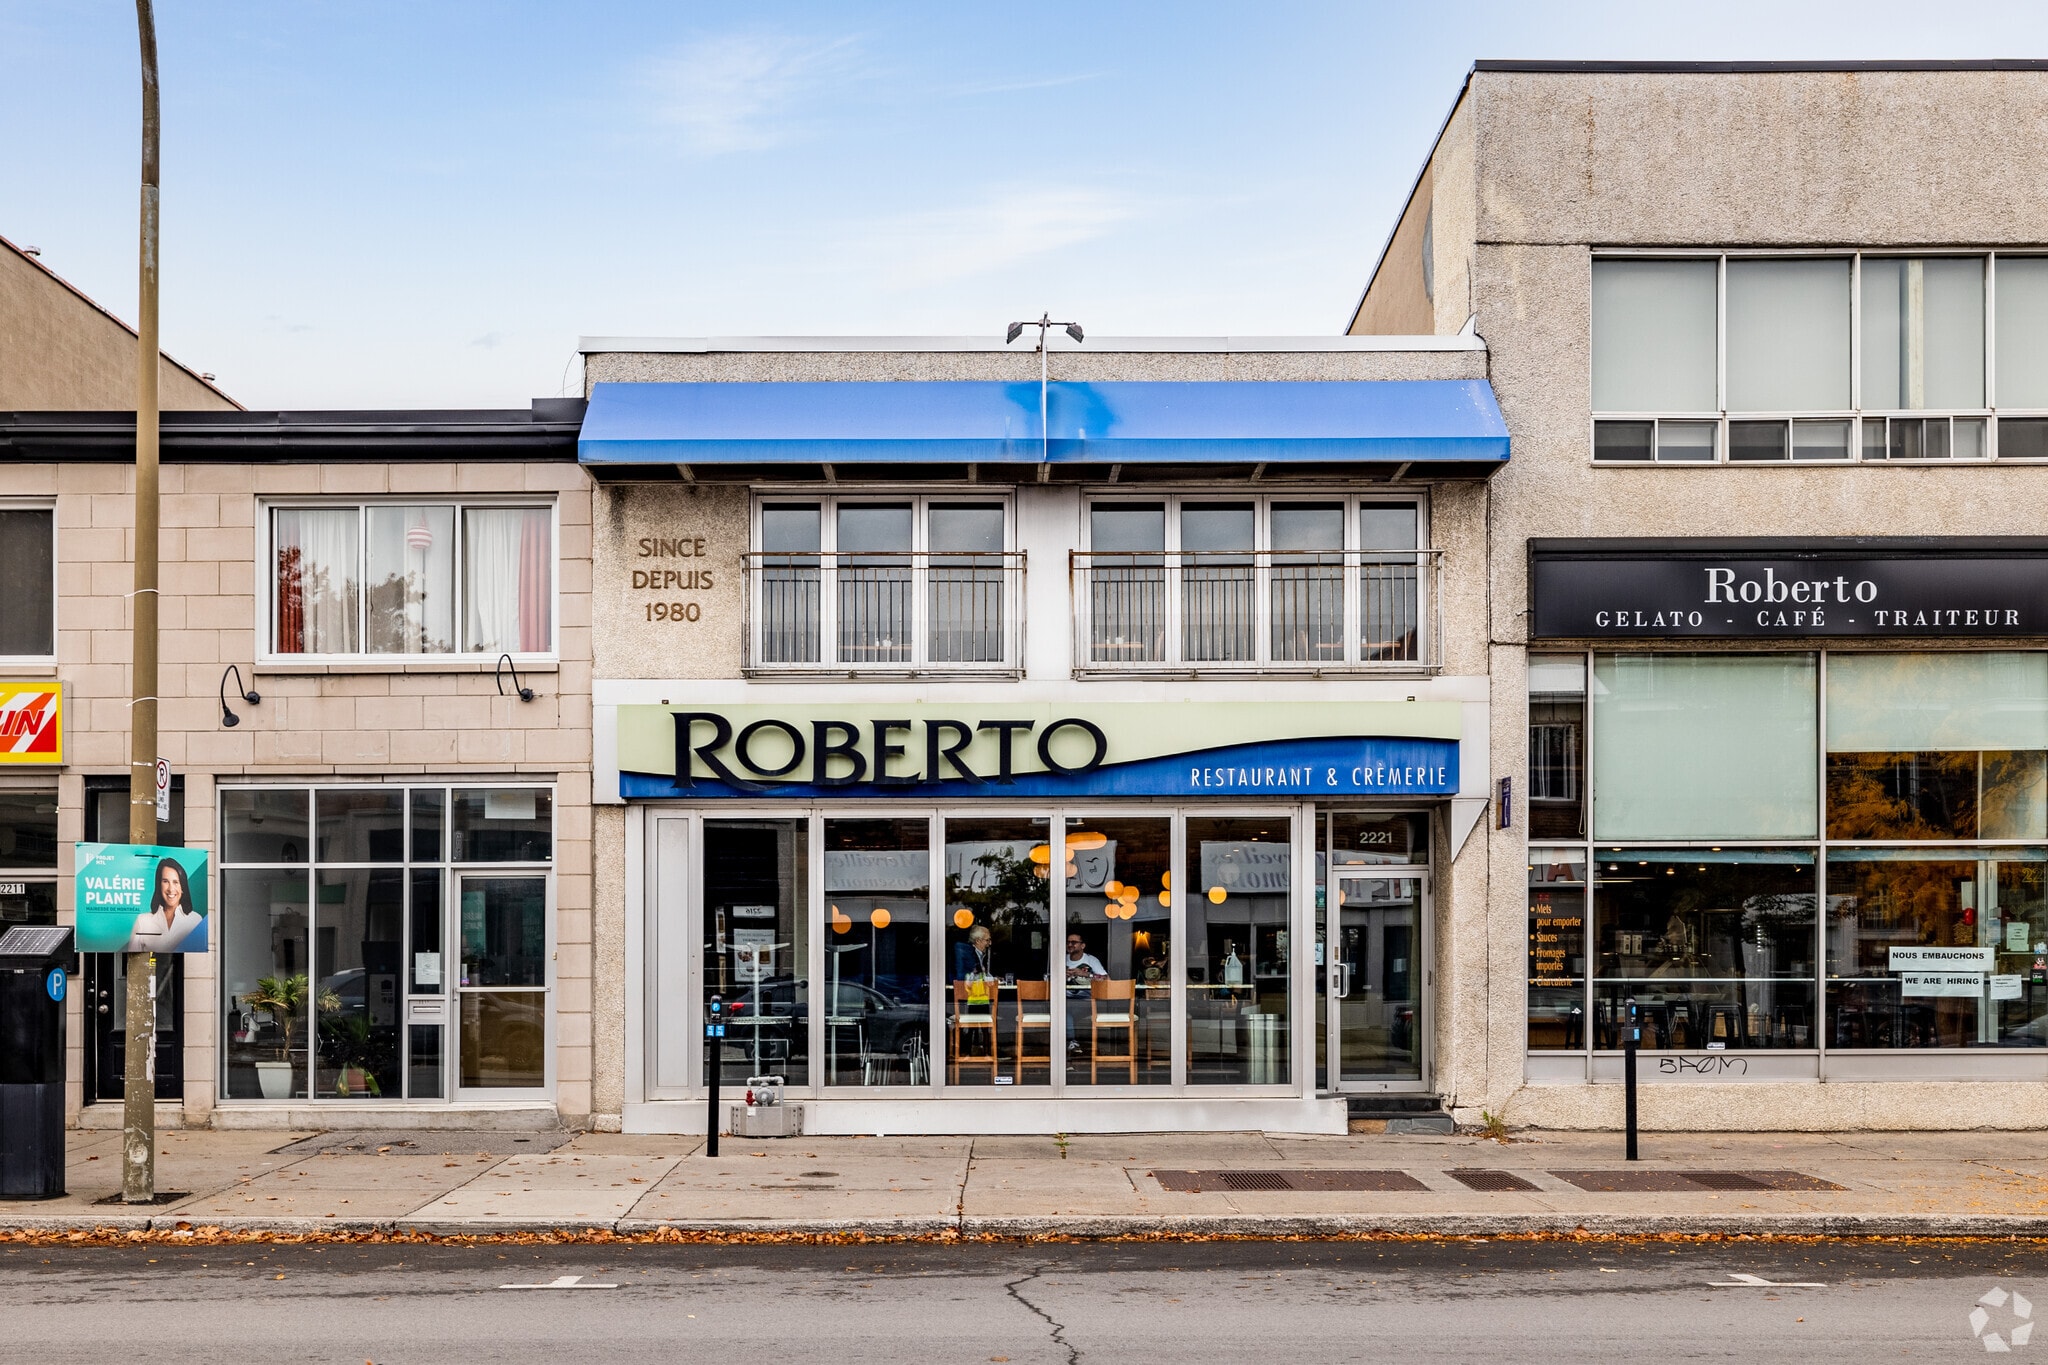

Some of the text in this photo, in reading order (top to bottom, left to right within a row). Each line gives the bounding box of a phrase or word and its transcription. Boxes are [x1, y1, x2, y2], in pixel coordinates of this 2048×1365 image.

[638, 537, 706, 557] SINCE
[632, 569, 714, 590] DEPUIS
[1703, 567, 1879, 603] Roberto
[645, 601, 701, 622] 1980
[1595, 610, 1704, 628] GELATO
[1756, 606, 1826, 628] CAFÉ
[1875, 609, 2021, 627] TRAITEUR
[0, 709, 46, 736] IN
[670, 712, 1108, 791] ROBERTO
[1191, 763, 1447, 787] RESTAURANT & CRÈMERIE
[1359, 831, 1393, 845] 2221
[0, 884, 24, 894] 2211
[85, 874, 146, 891] VALÉRIE
[85, 891, 142, 906] PLANTE
[1536, 904, 1552, 914] Mets
[1536, 917, 1581, 929] pour emporter
[1536, 932, 1558, 942] Sauces
[1536, 947, 1566, 962] Fromages
[1922, 952, 1985, 960] EMBAUCHONS
